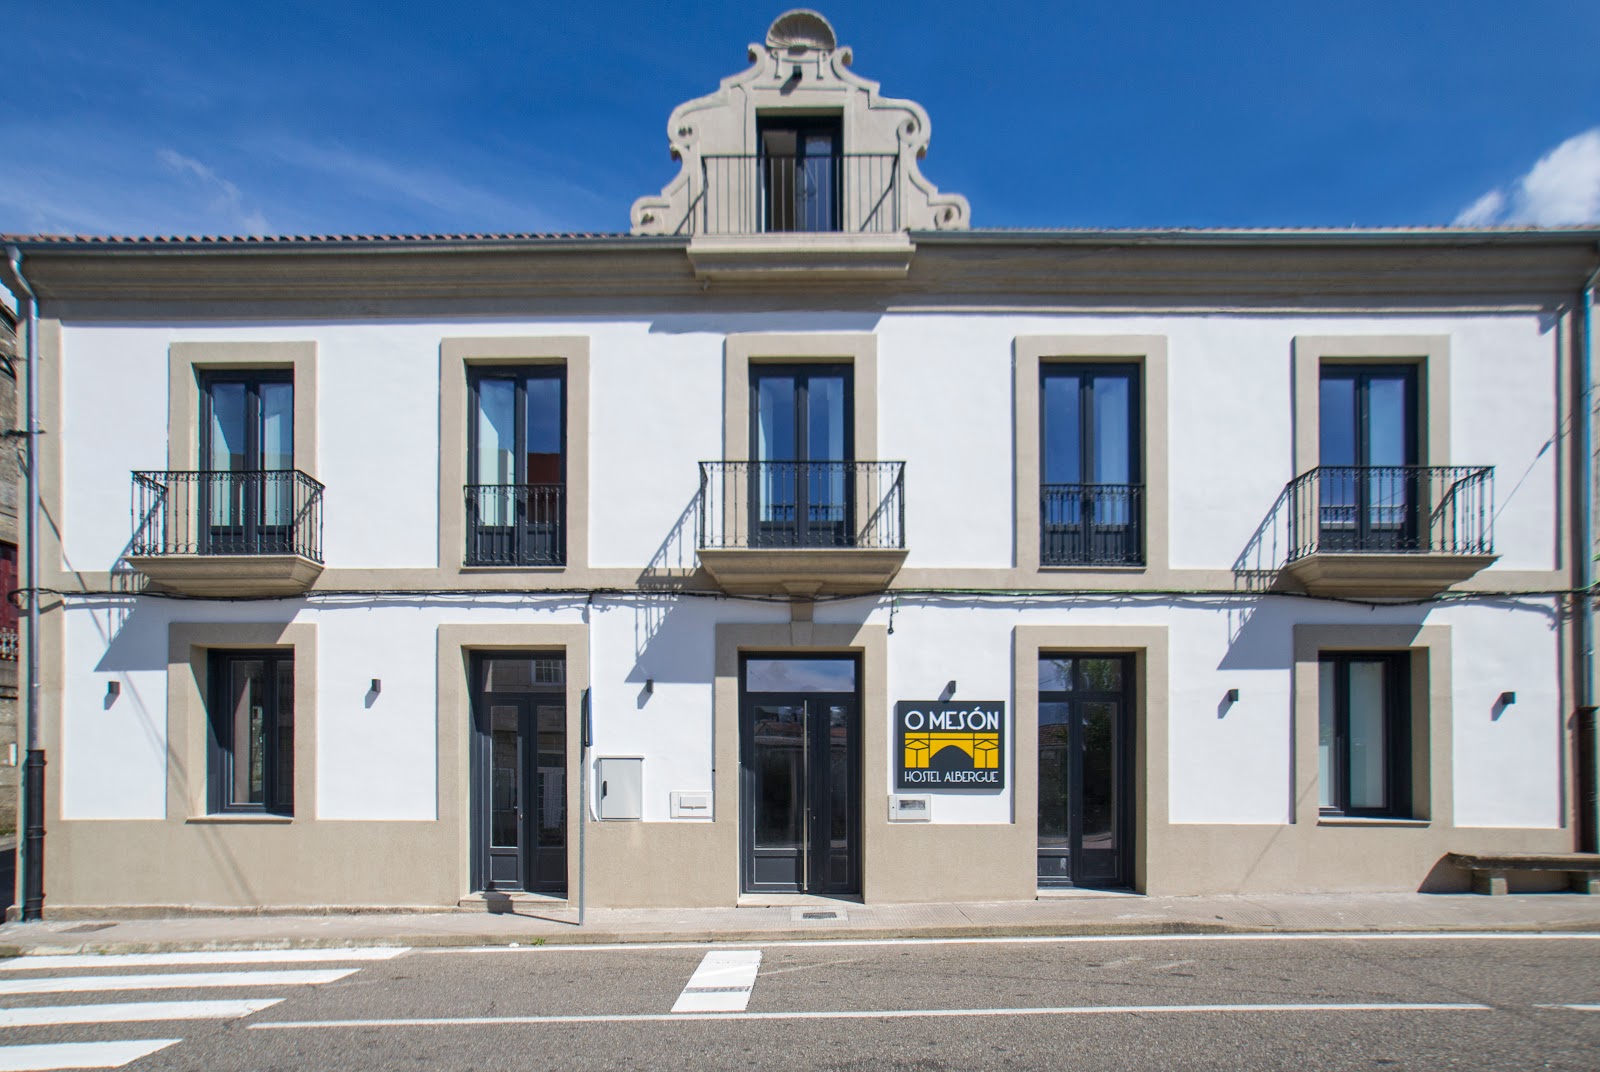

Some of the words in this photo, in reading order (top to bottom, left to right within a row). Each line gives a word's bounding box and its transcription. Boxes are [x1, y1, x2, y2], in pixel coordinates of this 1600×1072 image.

[904, 710, 925, 730] O
[929, 706, 999, 730] MESÓN
[904, 771, 941, 782] HOSTEL
[944, 771, 999, 782] ALBERGUE
